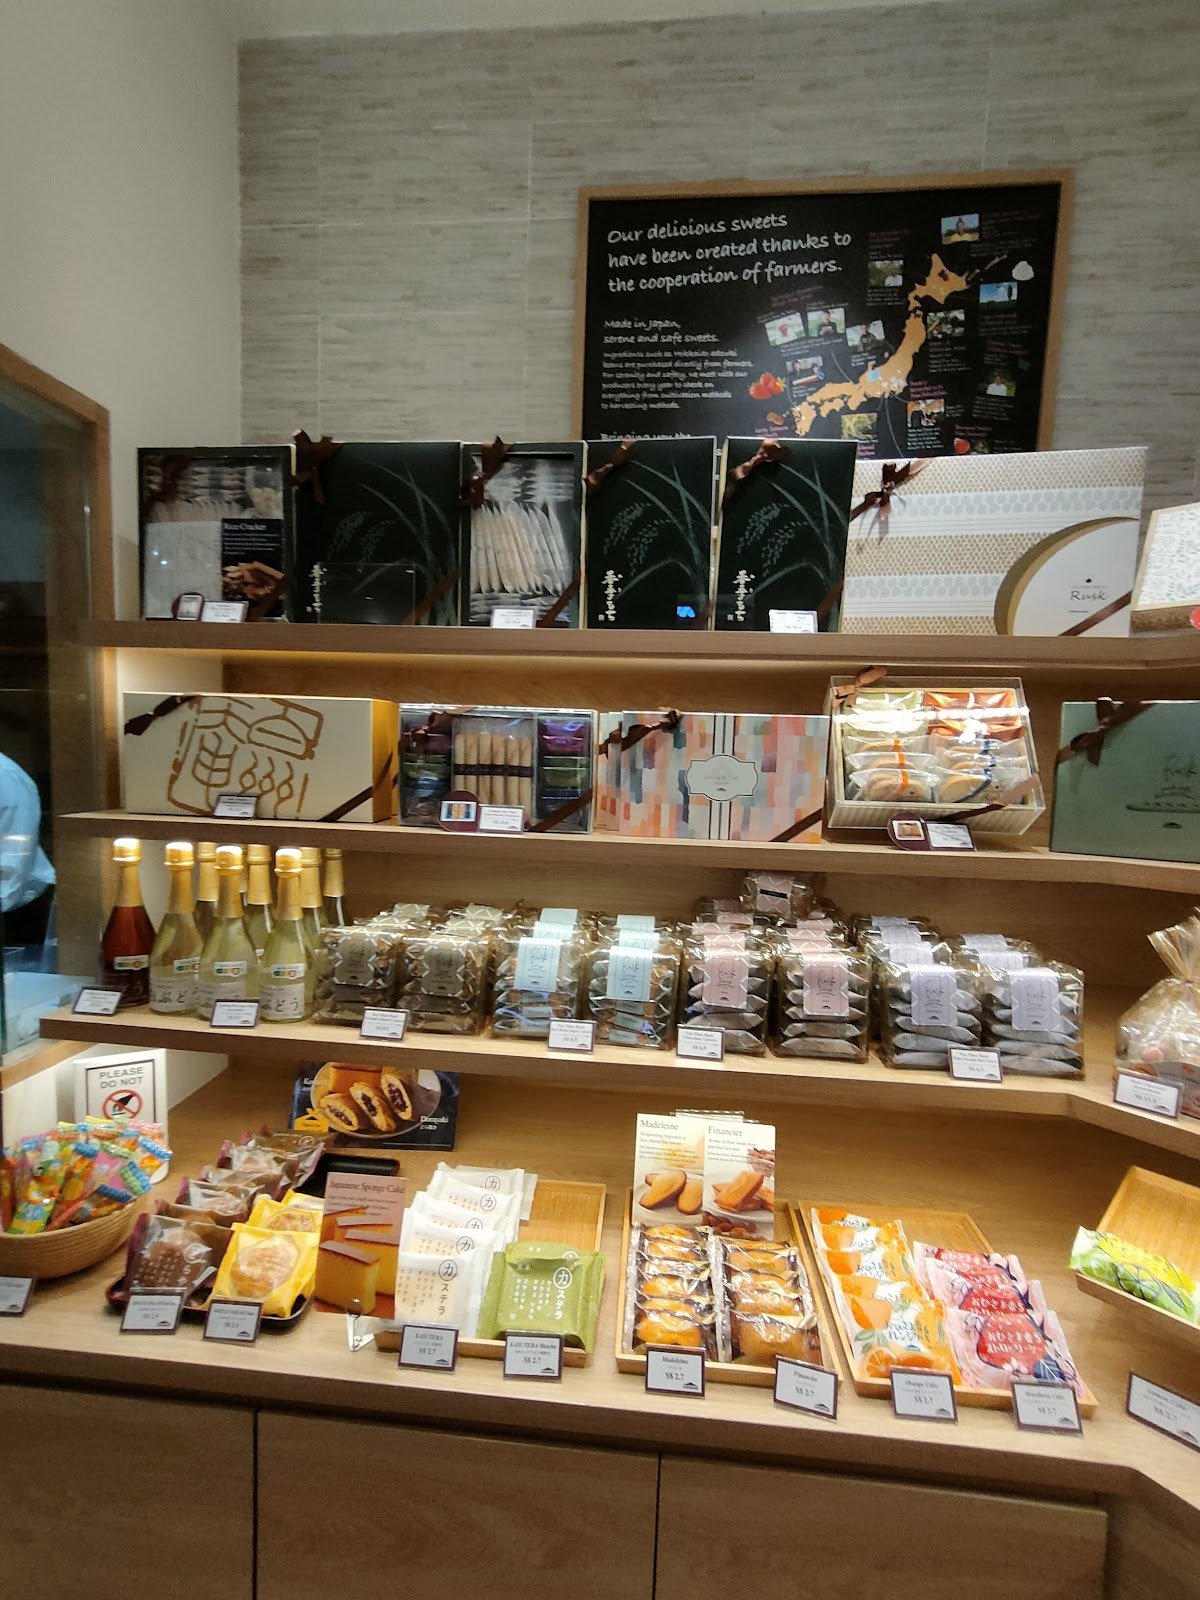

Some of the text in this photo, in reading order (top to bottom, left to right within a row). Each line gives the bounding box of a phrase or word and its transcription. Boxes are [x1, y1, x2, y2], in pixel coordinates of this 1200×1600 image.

[607, 213, 788, 244] Our delicious sweets
[607, 252, 649, 269] have
[651, 248, 693, 264] been
[695, 238, 758, 260] created
[762, 233, 830, 254] thanks
[833, 231, 852, 247] to
[607, 259, 843, 294] the cooperation of farmers.
[603, 318, 632, 329] Made
[634, 317, 647, 329] in
[603, 335, 635, 344] serene
[637, 333, 659, 343] and
[660, 331, 683, 346] safe
[1070, 590, 1107, 601] Rusk
[99, 1066, 145, 1080] PLEASE
[100, 1076, 144, 1089] DO NOT
[640, 1119, 679, 1131] Madeleine
[708, 1125, 743, 1137] Financier
[328, 1180, 406, 1194] Japanese Sponge Cake
[438, 1259, 458, 1316] カステラ
[553, 1266, 573, 1320] カステラ
[427, 1348, 436, 1356] 2.7
[532, 1357, 542, 1365] 2.7
[661, 1355, 689, 1365] Madeleine
[674, 1372, 685, 1381] 2.7
[793, 1369, 819, 1383] Financier
[905, 1380, 924, 1390] Orange
[804, 1387, 815, 1397] 2.7
